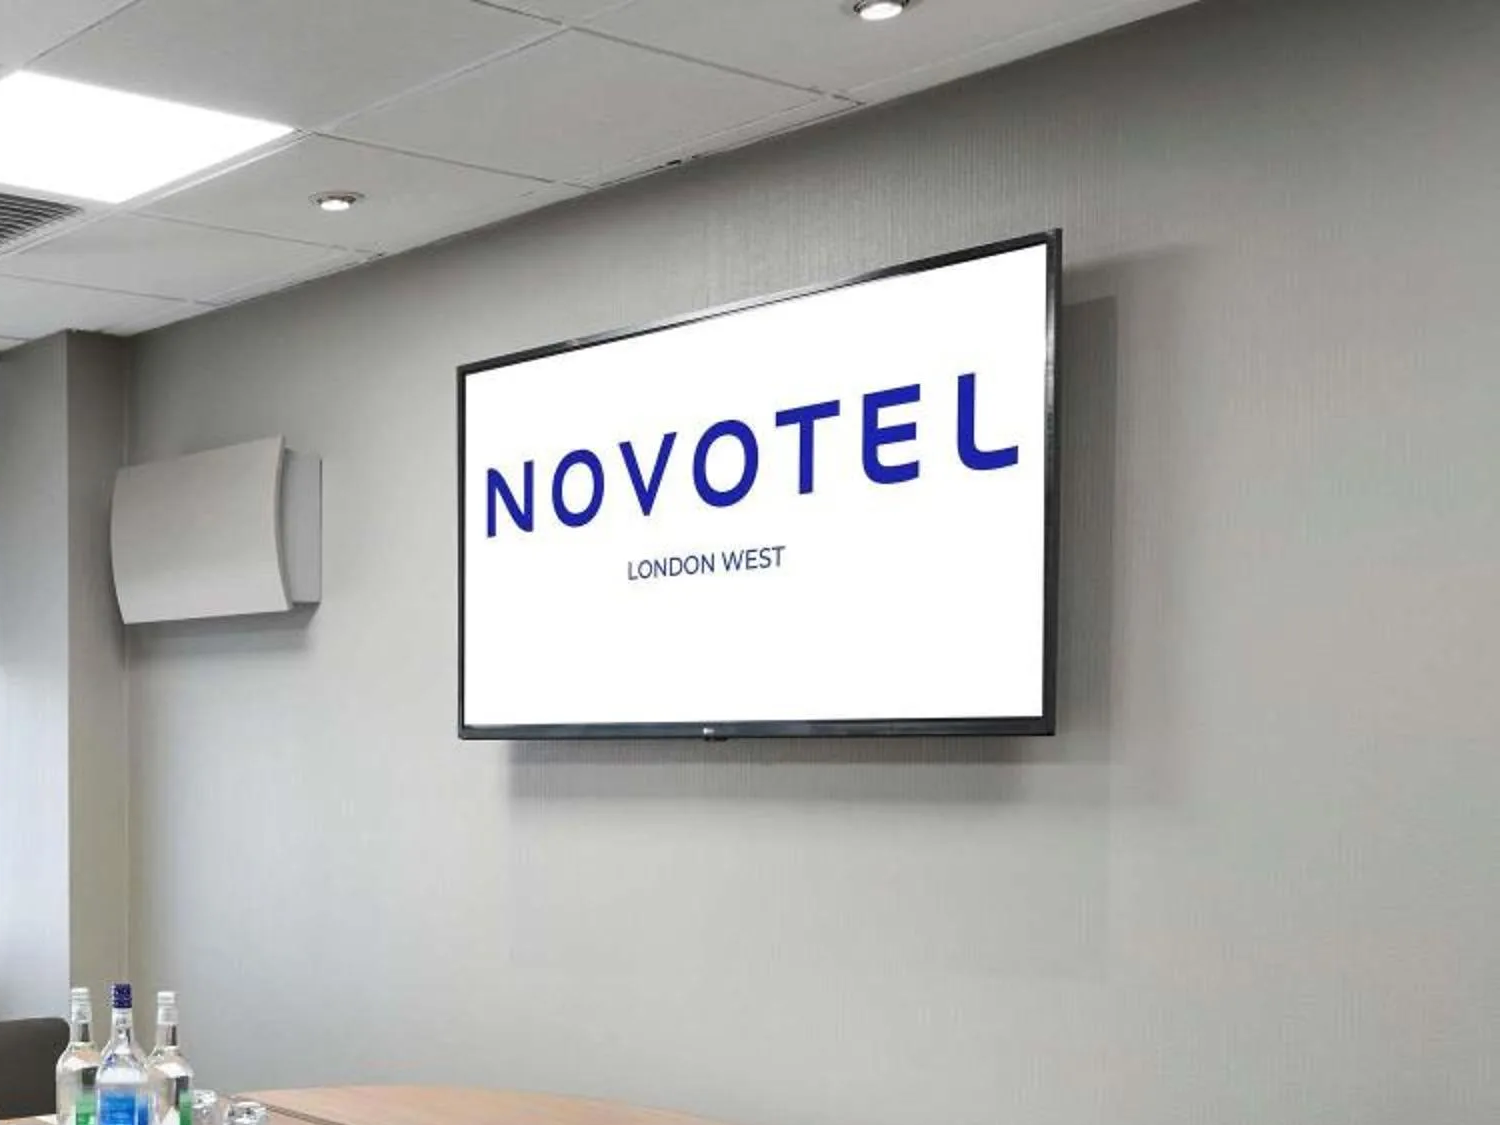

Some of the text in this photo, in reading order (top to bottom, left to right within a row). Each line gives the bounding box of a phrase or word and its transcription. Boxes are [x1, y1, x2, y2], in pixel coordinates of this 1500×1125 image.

[486, 372, 1019, 538] NOVOTEL
[627, 545, 786, 581] LONDON WEST
